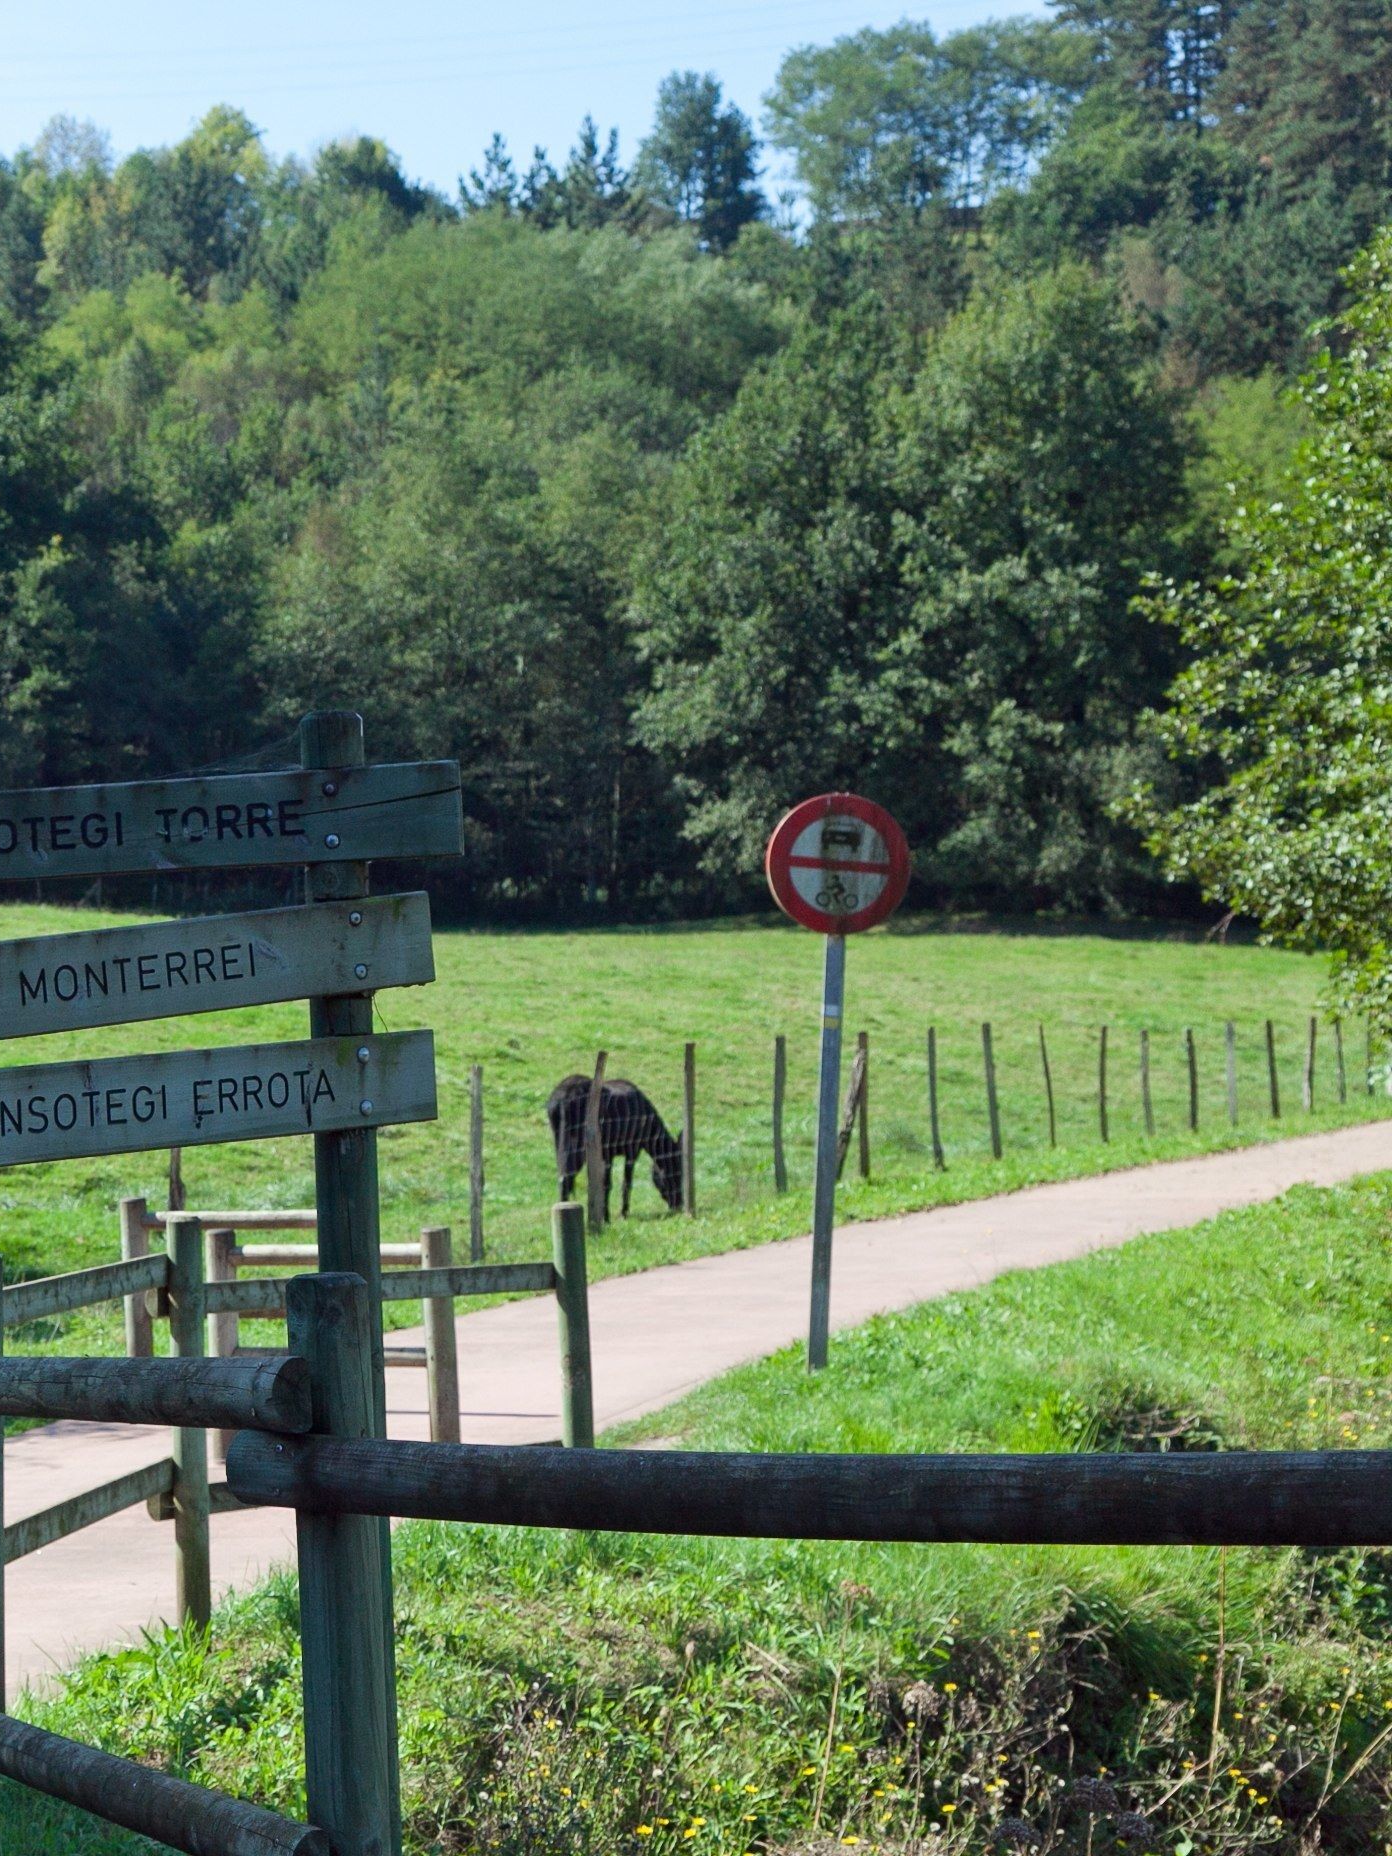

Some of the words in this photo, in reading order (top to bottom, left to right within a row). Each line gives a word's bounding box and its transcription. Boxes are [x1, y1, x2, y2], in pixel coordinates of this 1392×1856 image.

[156, 800, 307, 841] TORRE
[19, 943, 256, 1006] MONTERREI
[193, 1068, 336, 1118] ERROTA
